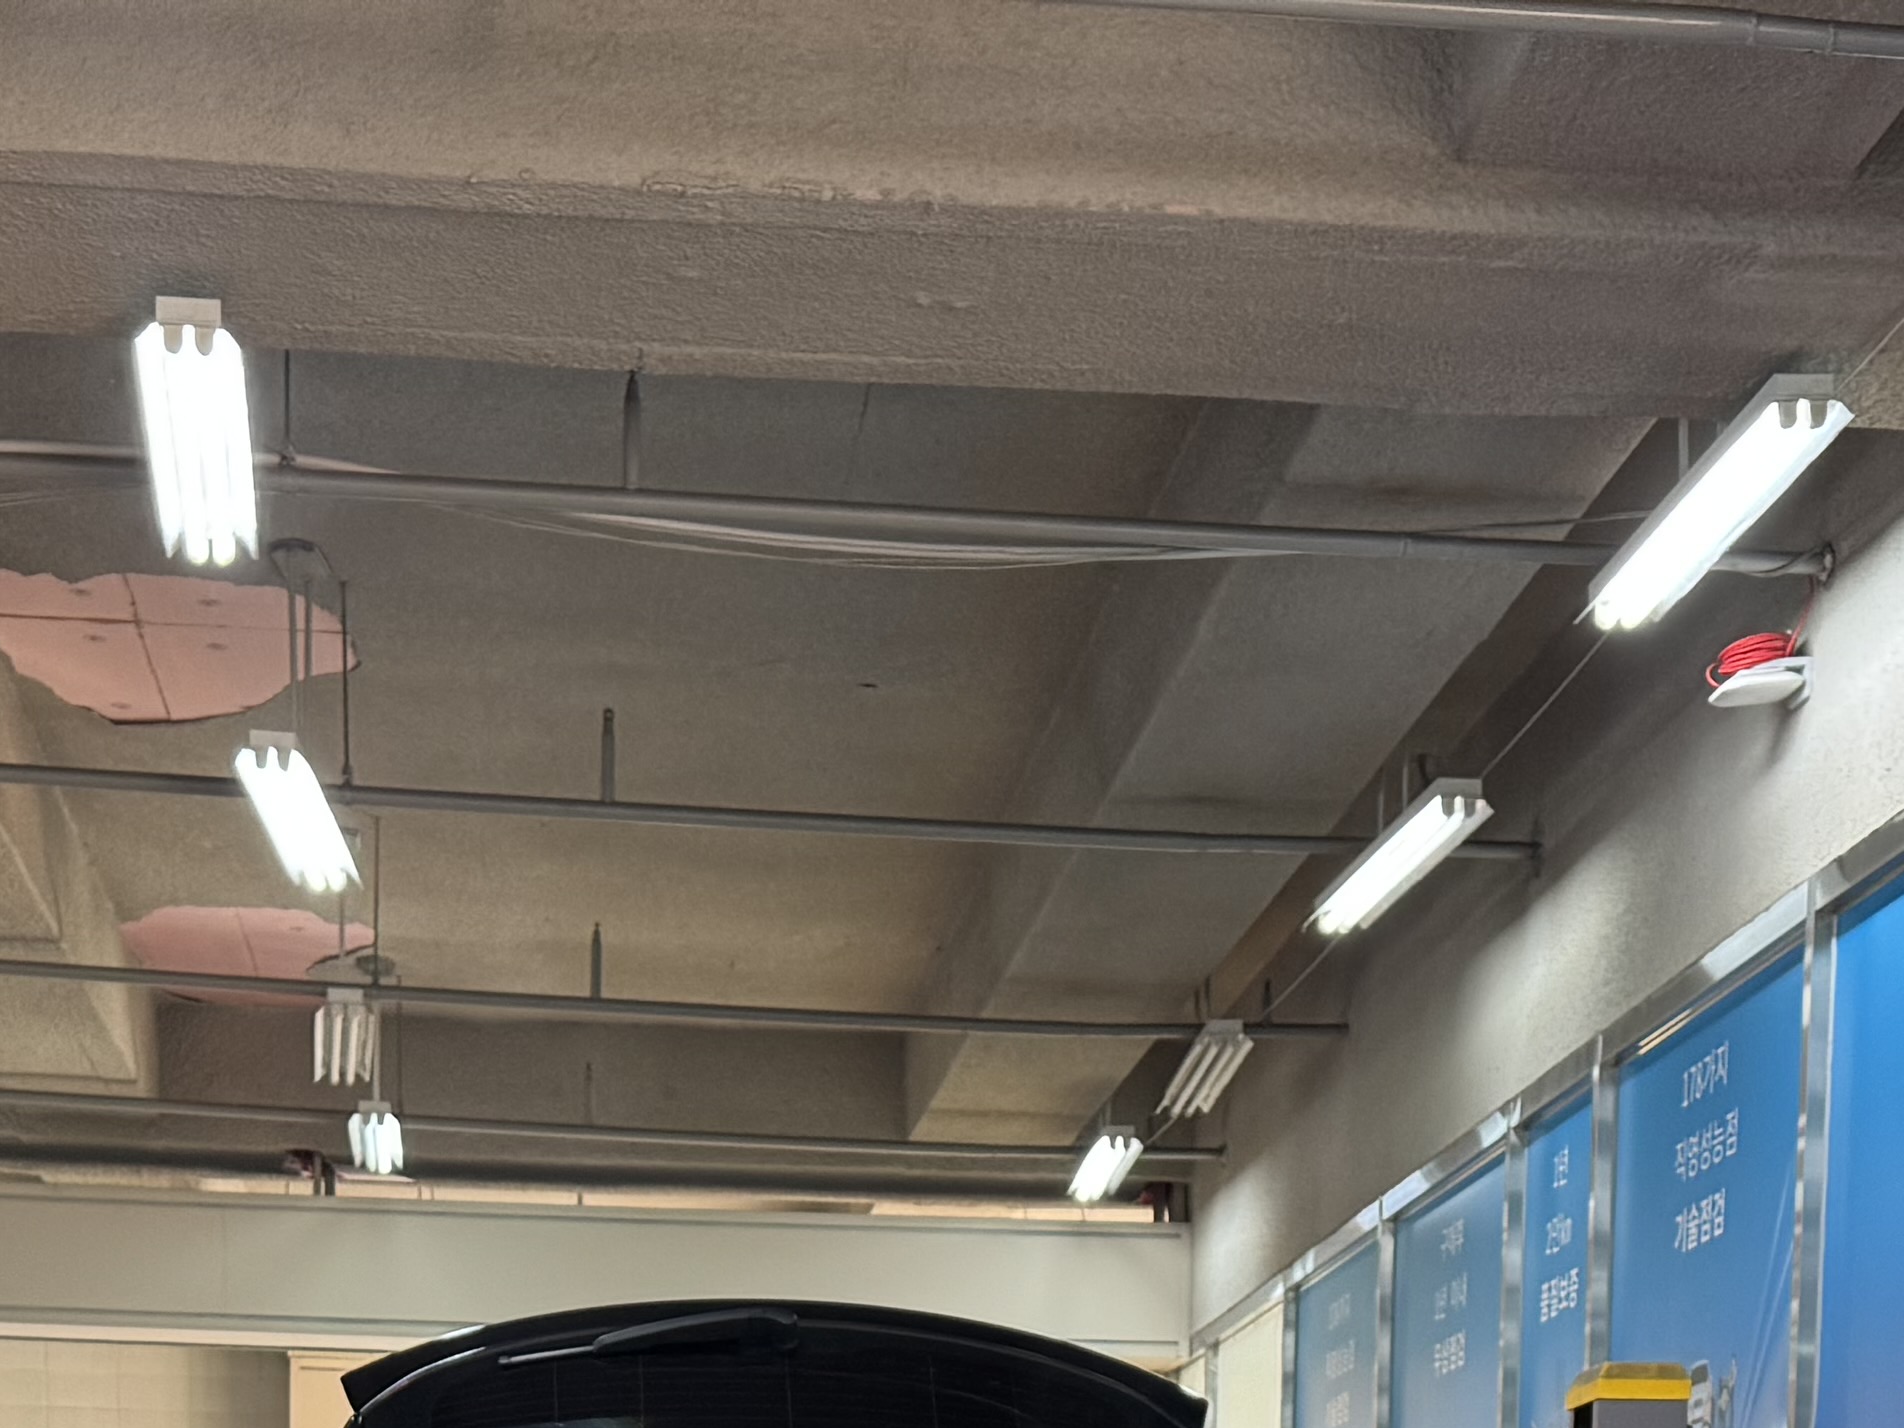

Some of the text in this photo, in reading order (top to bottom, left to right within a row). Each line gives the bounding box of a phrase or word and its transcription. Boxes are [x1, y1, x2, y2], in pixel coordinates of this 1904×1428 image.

[1681, 1040, 1730, 1108] 178가지
[1674, 1106, 1739, 1183] 직영성능점
[1674, 1187, 1726, 1254] 기술점검
